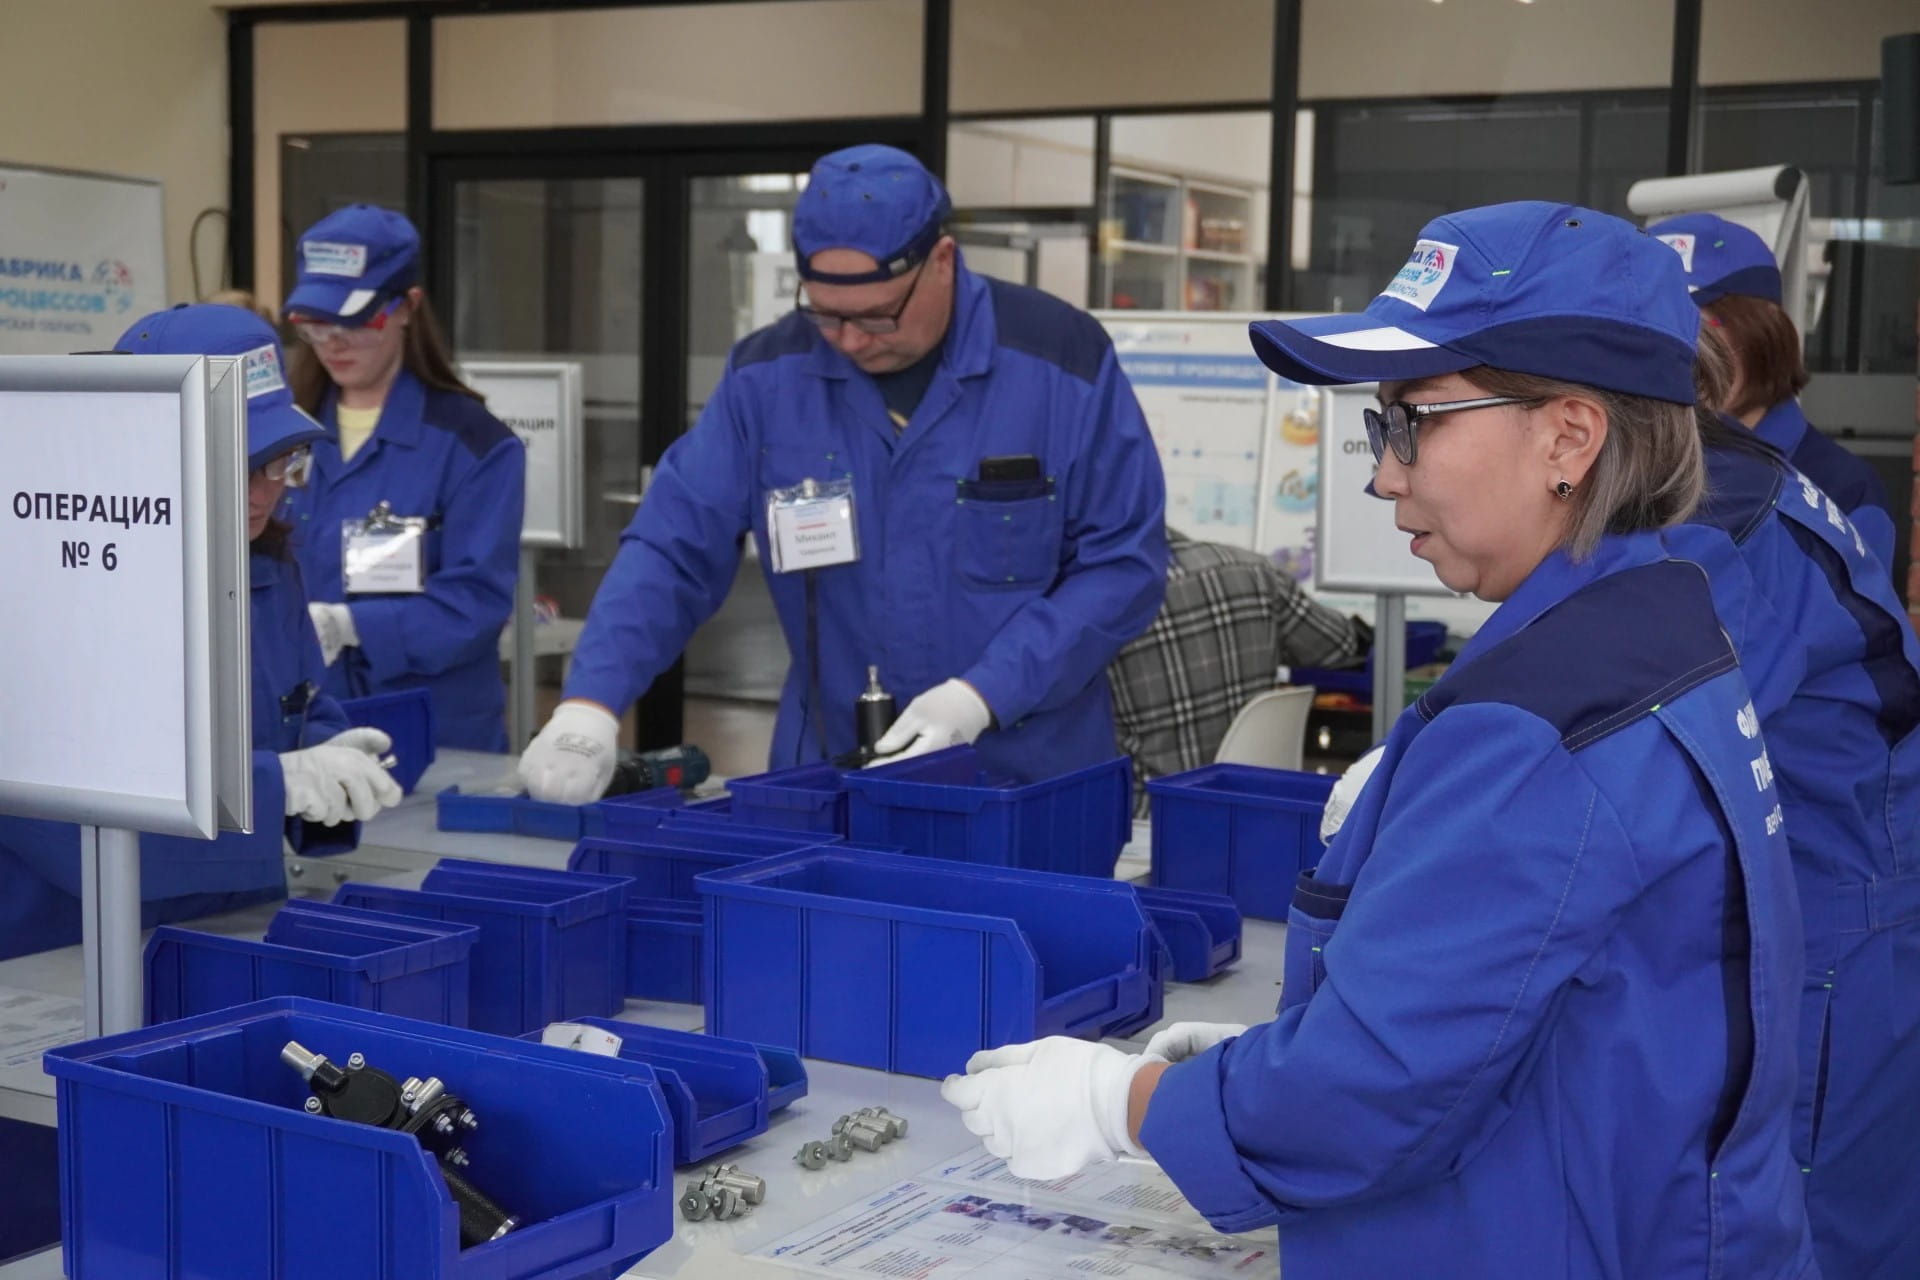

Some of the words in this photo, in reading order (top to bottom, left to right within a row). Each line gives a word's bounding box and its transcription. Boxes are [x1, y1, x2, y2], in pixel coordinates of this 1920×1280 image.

[0, 258, 83, 282] АБРИКА
[0, 287, 107, 314] РОЦЕССОВ
[13, 491, 171, 529] ОПЕРАЦИЯ
[62, 540, 90, 568] №
[102, 543, 118, 571] 6
